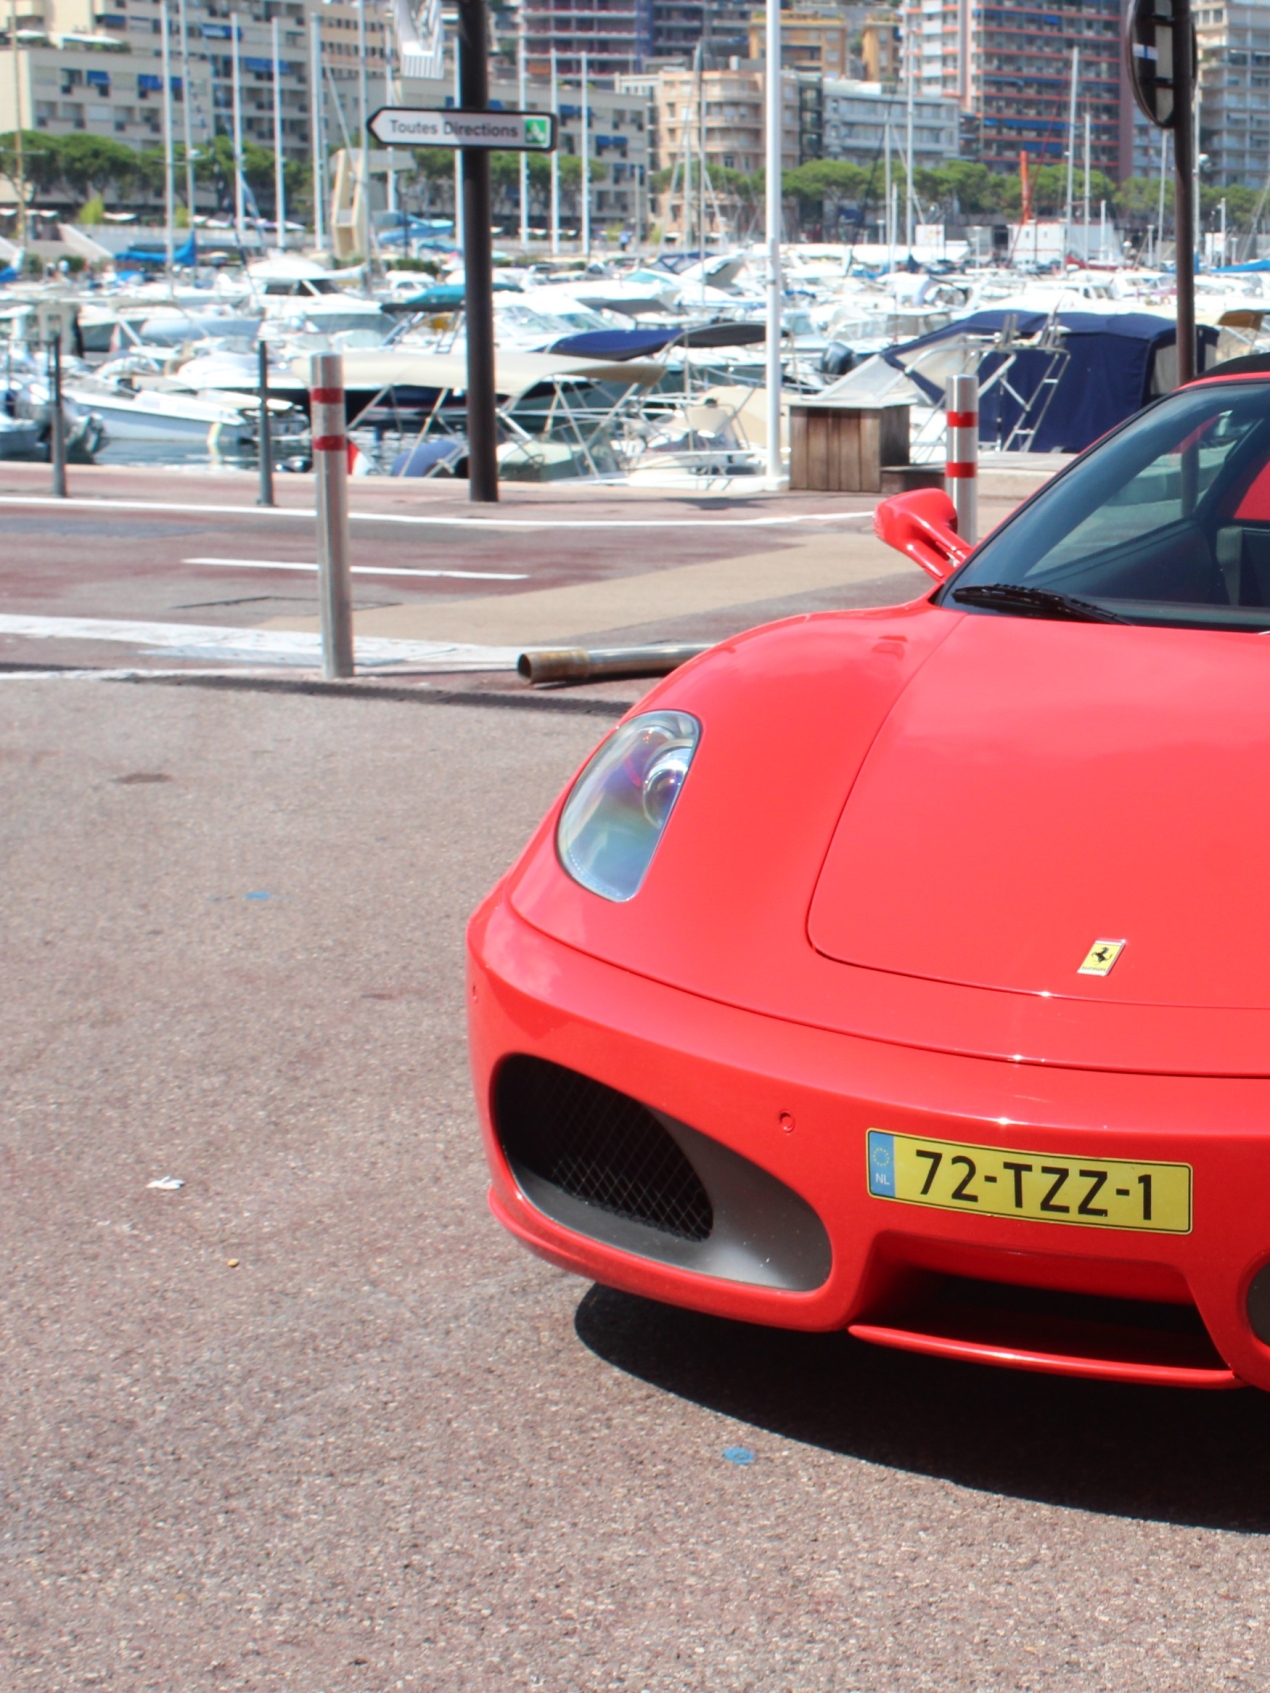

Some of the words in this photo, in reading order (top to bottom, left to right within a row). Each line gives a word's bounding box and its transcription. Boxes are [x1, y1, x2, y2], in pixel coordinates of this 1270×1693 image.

[390, 119, 438, 135] Toutes
[443, 121, 519, 138] Directions
[874, 1172, 890, 1186] NL
[915, 1149, 1152, 1221] 72-TZZ-1
